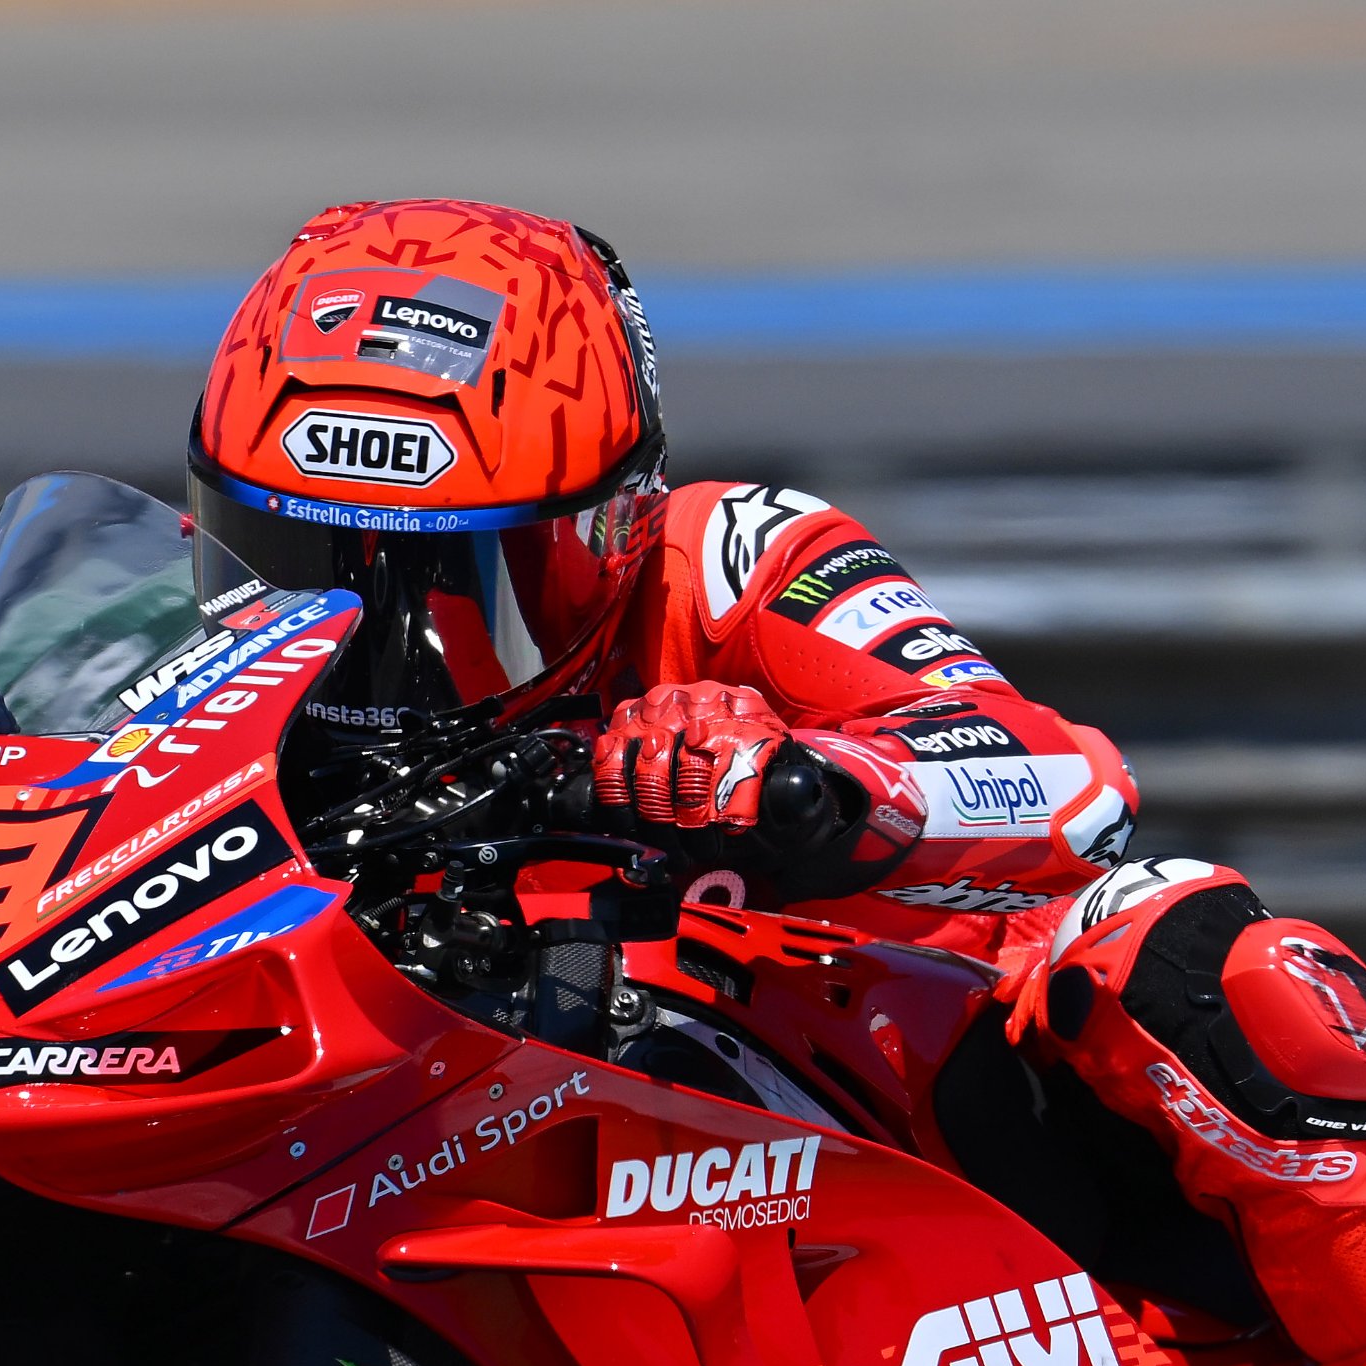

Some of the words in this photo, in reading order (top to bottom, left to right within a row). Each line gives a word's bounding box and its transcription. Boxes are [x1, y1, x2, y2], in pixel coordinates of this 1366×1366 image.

[316, 294, 359, 306] DUCATI
[381, 300, 479, 340] Lenovo
[410, 336, 448, 352] FACTORY
[449, 345, 473, 359] TEAM
[305, 426, 431, 474] SHOEI
[285, 498, 351, 528] Estrella
[355, 509, 421, 532] Galicia
[199, 578, 268, 616] MARQUEZ
[175, 603, 329, 709] ADVANCE
[901, 627, 983, 660] elic
[117, 630, 236, 714] WRS
[158, 638, 337, 756] riello
[944, 763, 1048, 824] Unipol
[36, 760, 265, 914] FRECCIAROSSA
[6, 825, 259, 993] Lenovo
[367, 1135, 468, 1209] Audi
[475, 1068, 591, 1153] Sport
[1305, 1116, 1348, 1130] one
[605, 1135, 822, 1218] DUCATI
[689, 1196, 812, 1230] DESMOSEDICI
